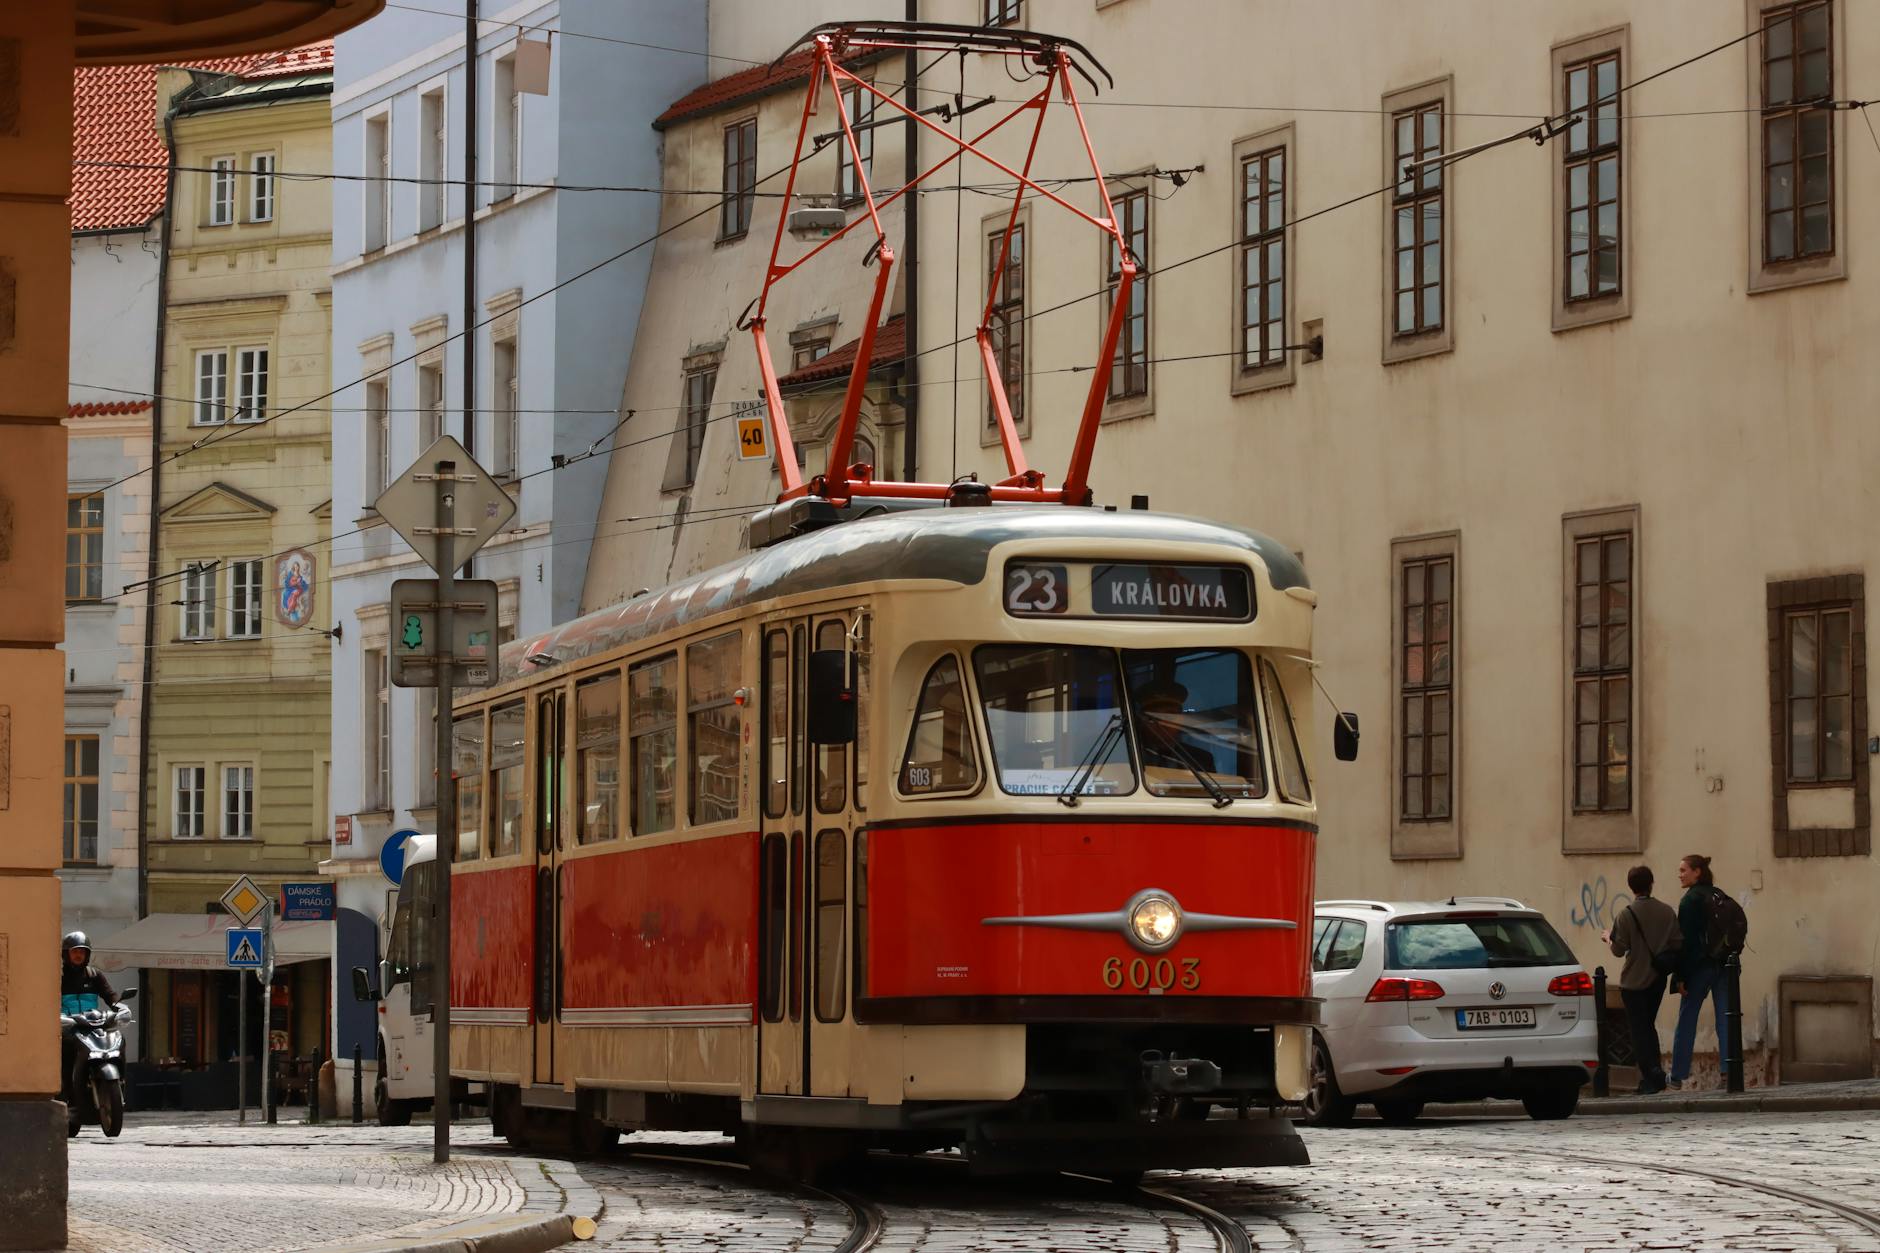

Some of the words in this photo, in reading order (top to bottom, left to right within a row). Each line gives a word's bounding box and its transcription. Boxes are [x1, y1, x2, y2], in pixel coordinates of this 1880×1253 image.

[741, 428, 762, 446] 40
[1008, 568, 1058, 611] 23
[1110, 578, 1228, 609] KRÁLOVKA
[909, 767, 931, 786] 603
[287, 885, 322, 897] DÁMSKÉ
[298, 896, 333, 906] PRÁDLO
[1102, 956, 1201, 990] 6003
[1467, 1012, 1491, 1025] 7AB
[1499, 1010, 1530, 1024] 0103
